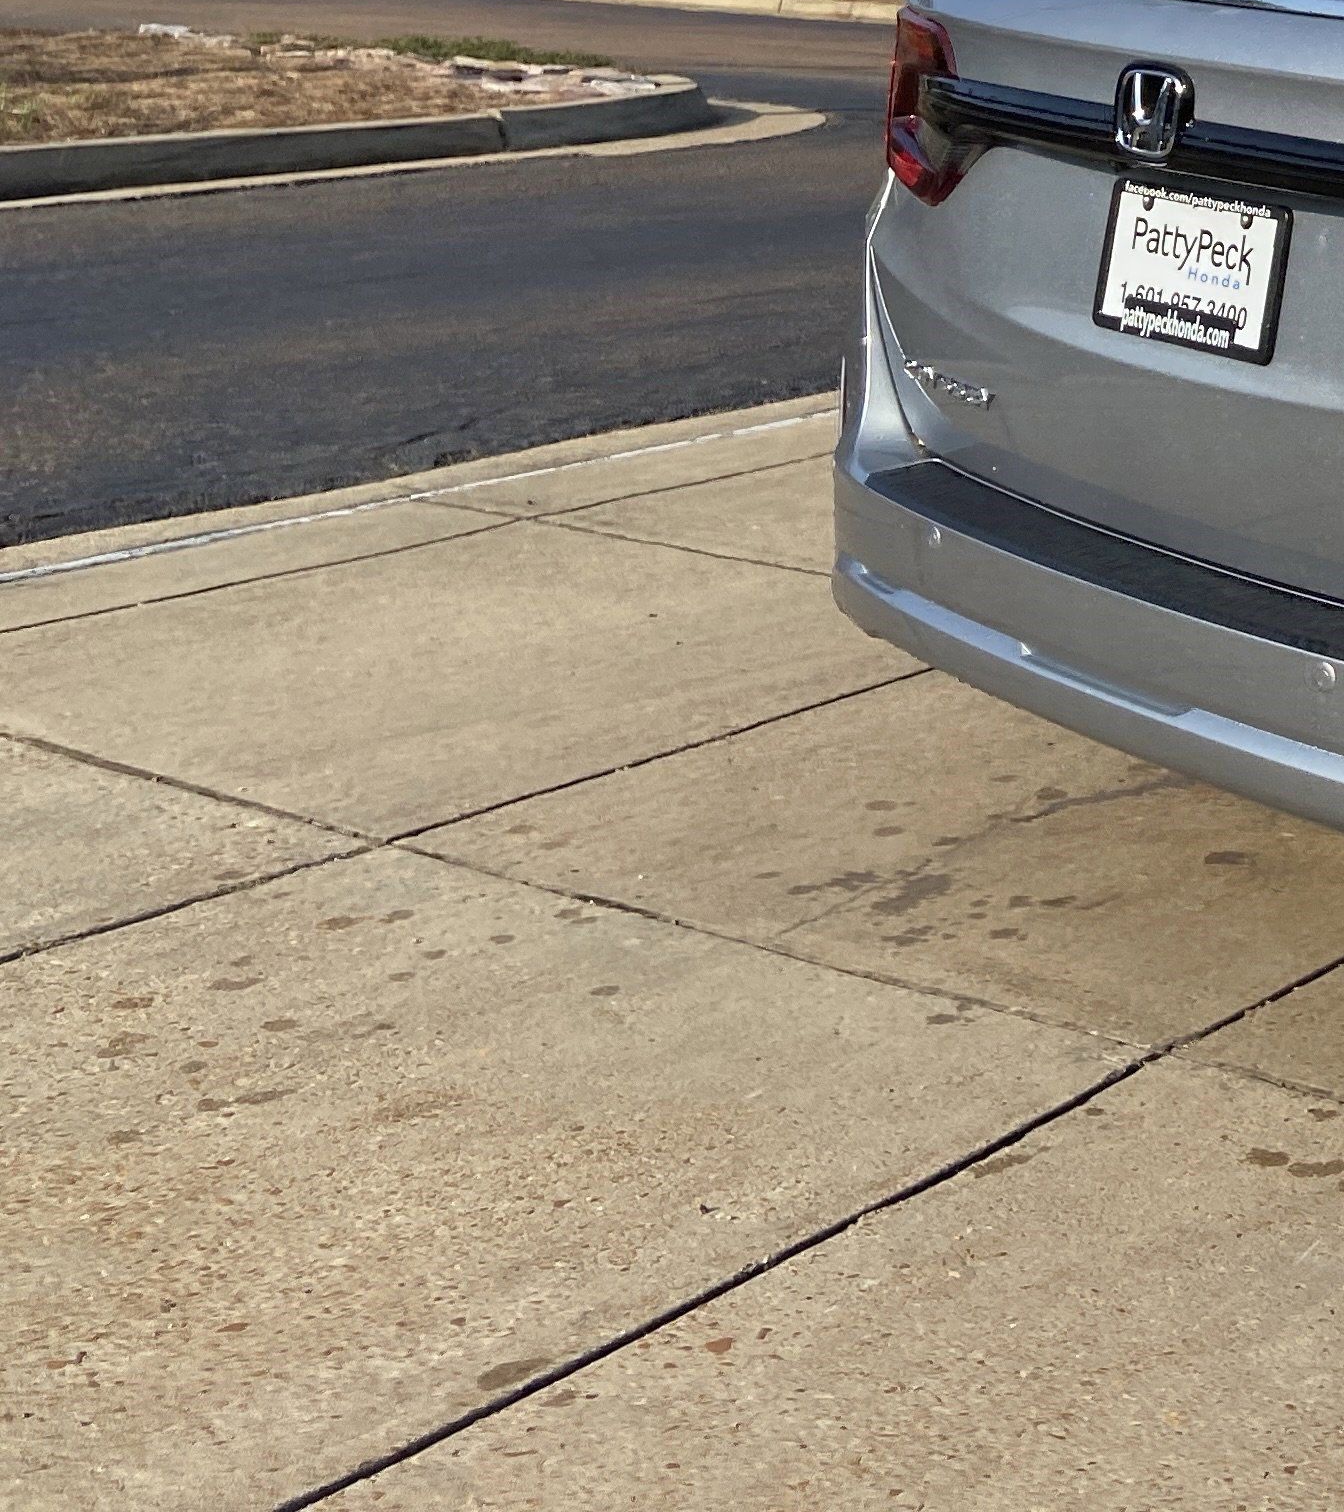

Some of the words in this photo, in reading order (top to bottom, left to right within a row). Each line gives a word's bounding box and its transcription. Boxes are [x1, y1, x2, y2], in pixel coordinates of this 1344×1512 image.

[1125, 181, 1271, 218] facebook.com/pattypeckhonda
[1131, 216, 1254, 286] PattyPeck
[1187, 267, 1241, 290] Honda
[1120, 307, 1230, 349] pattypeckhonda.com
